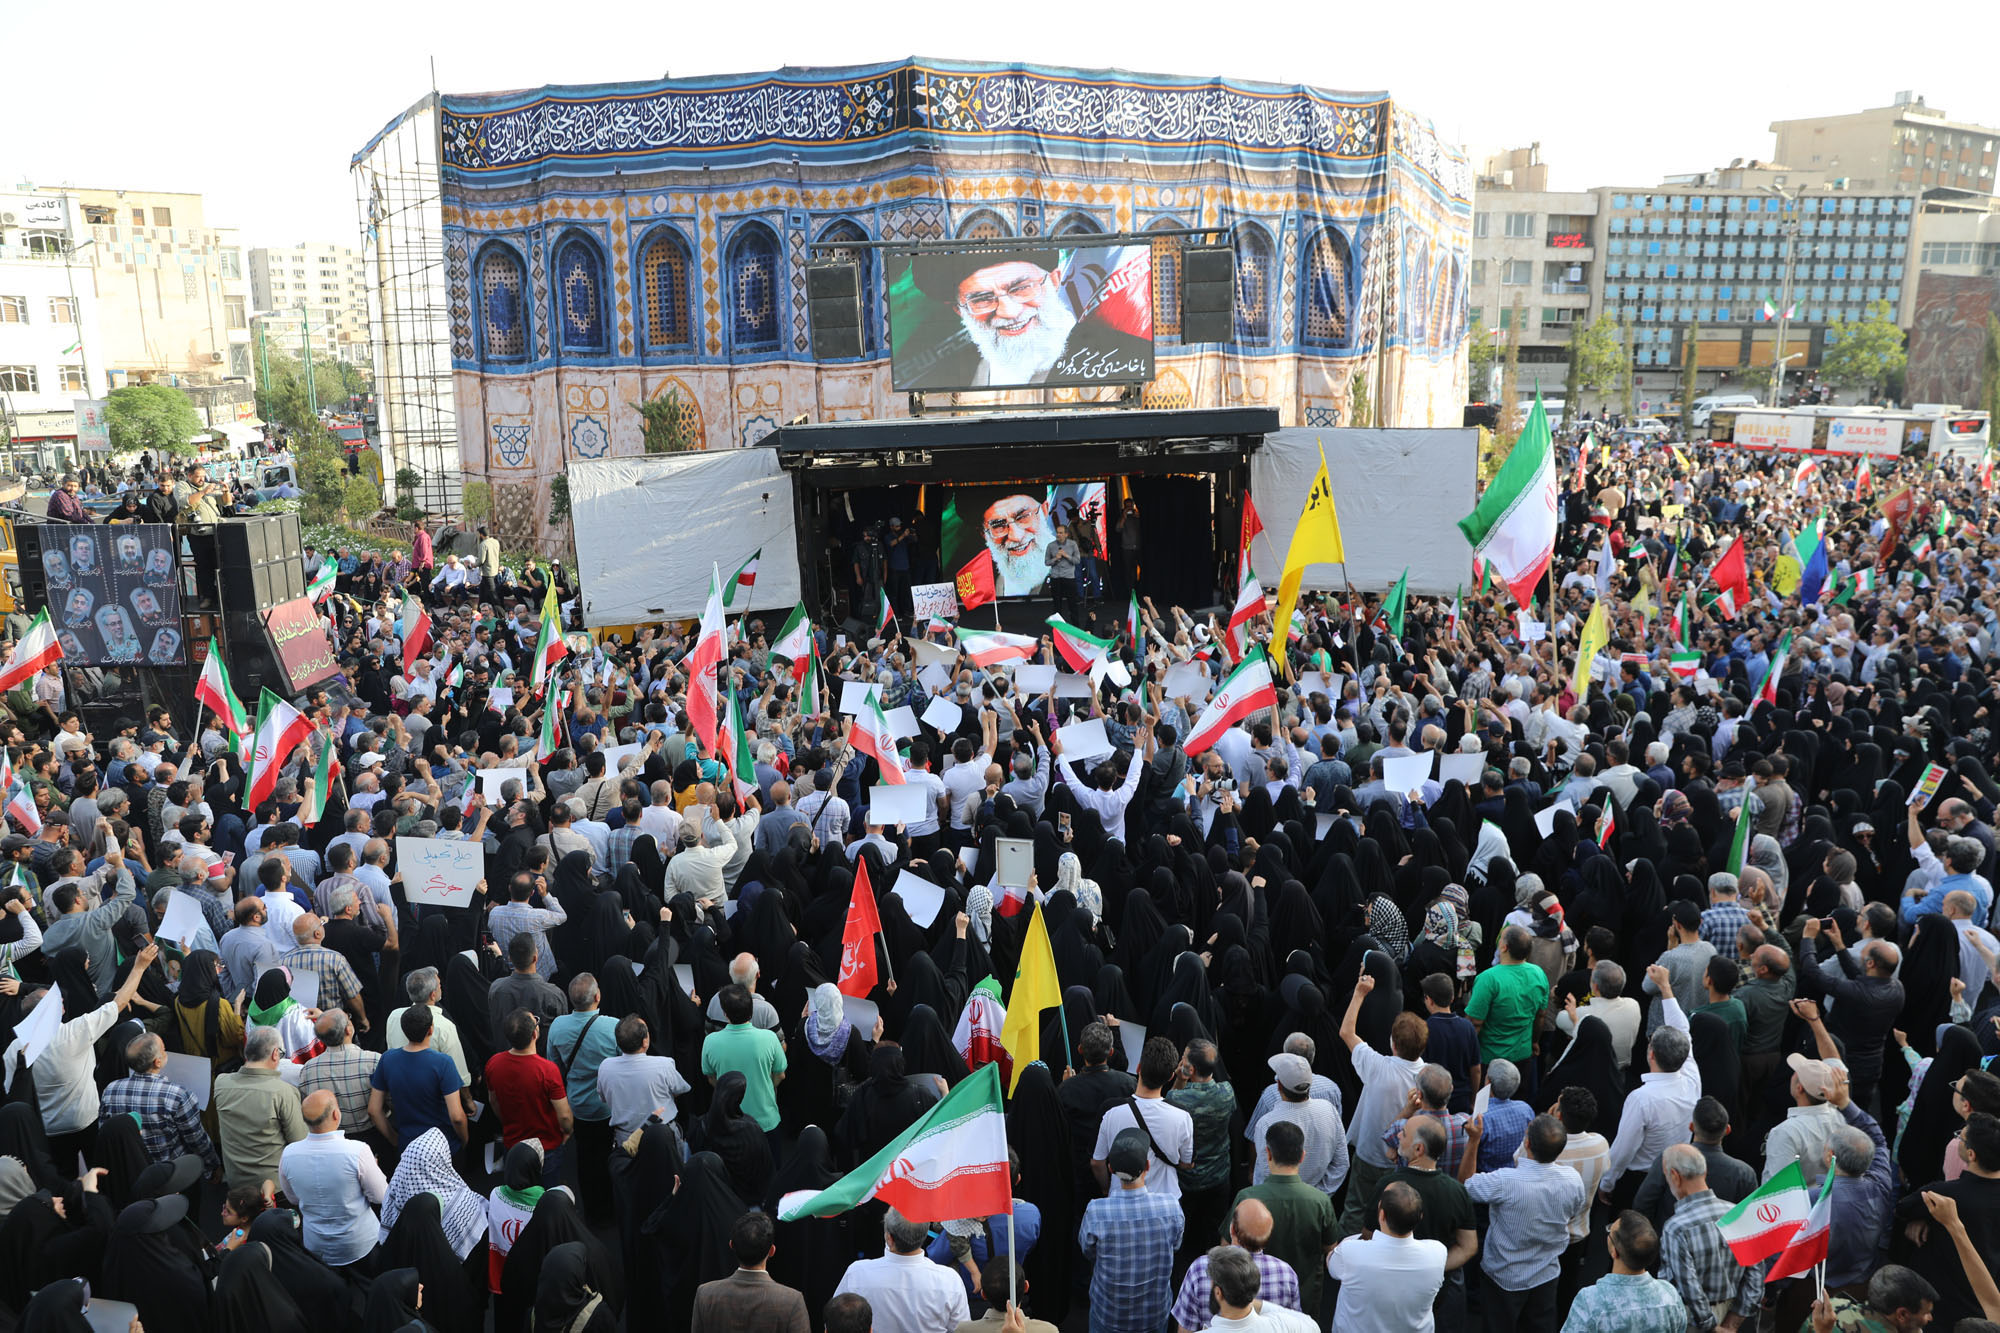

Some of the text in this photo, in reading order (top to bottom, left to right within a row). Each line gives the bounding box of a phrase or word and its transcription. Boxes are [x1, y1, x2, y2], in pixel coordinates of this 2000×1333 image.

[1736, 423, 1791, 437] AMBULANCE
[1874, 426, 1888, 436] 115
[422, 874, 463, 897] هرگز
